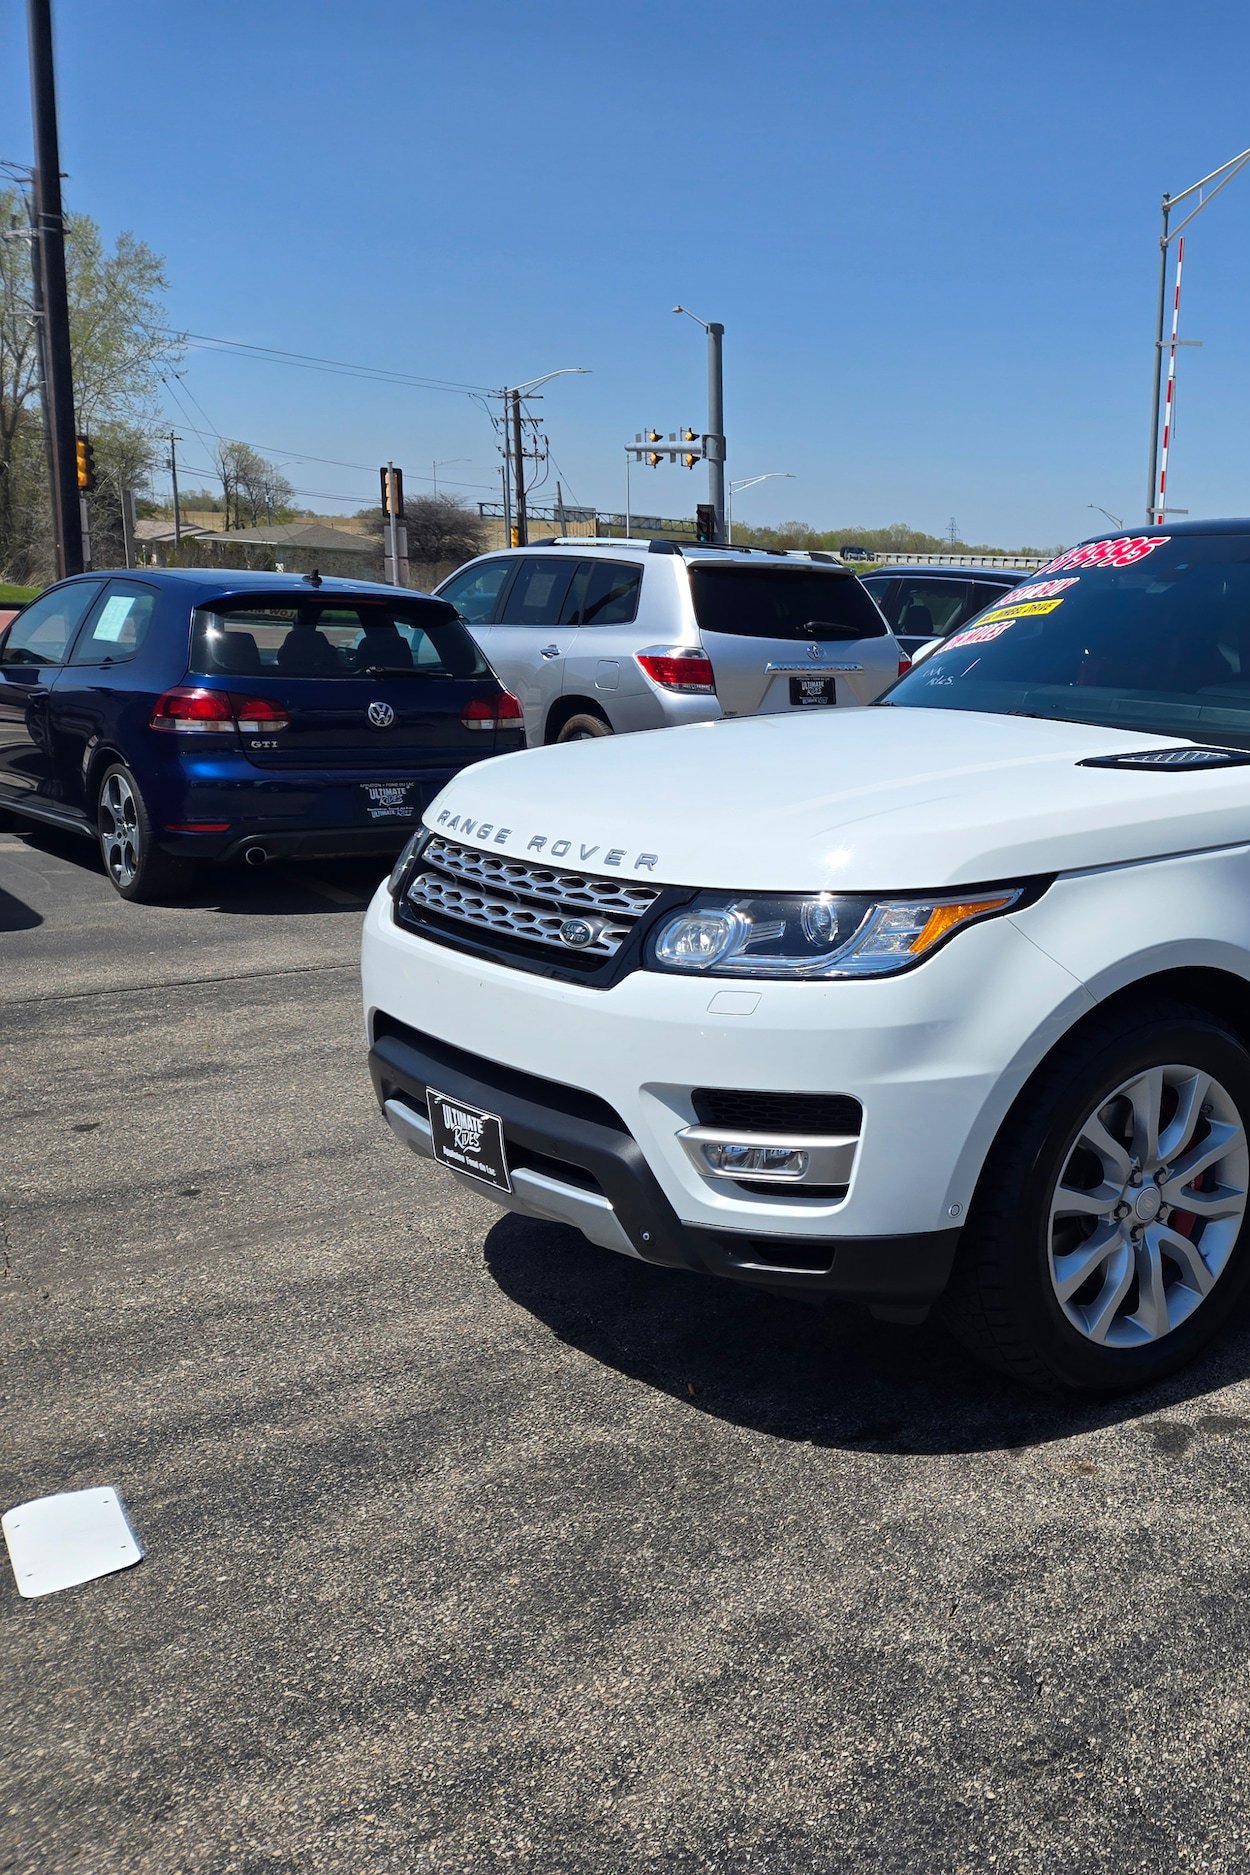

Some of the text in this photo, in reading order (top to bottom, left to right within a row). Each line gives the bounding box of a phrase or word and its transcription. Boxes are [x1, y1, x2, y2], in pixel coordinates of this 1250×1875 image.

[251, 740, 278, 748] GTI
[369, 788, 407, 800] ULTIMATE
[436, 809, 659, 872] RANGE ROVER
[442, 1103, 484, 1135] ULTIMATE
